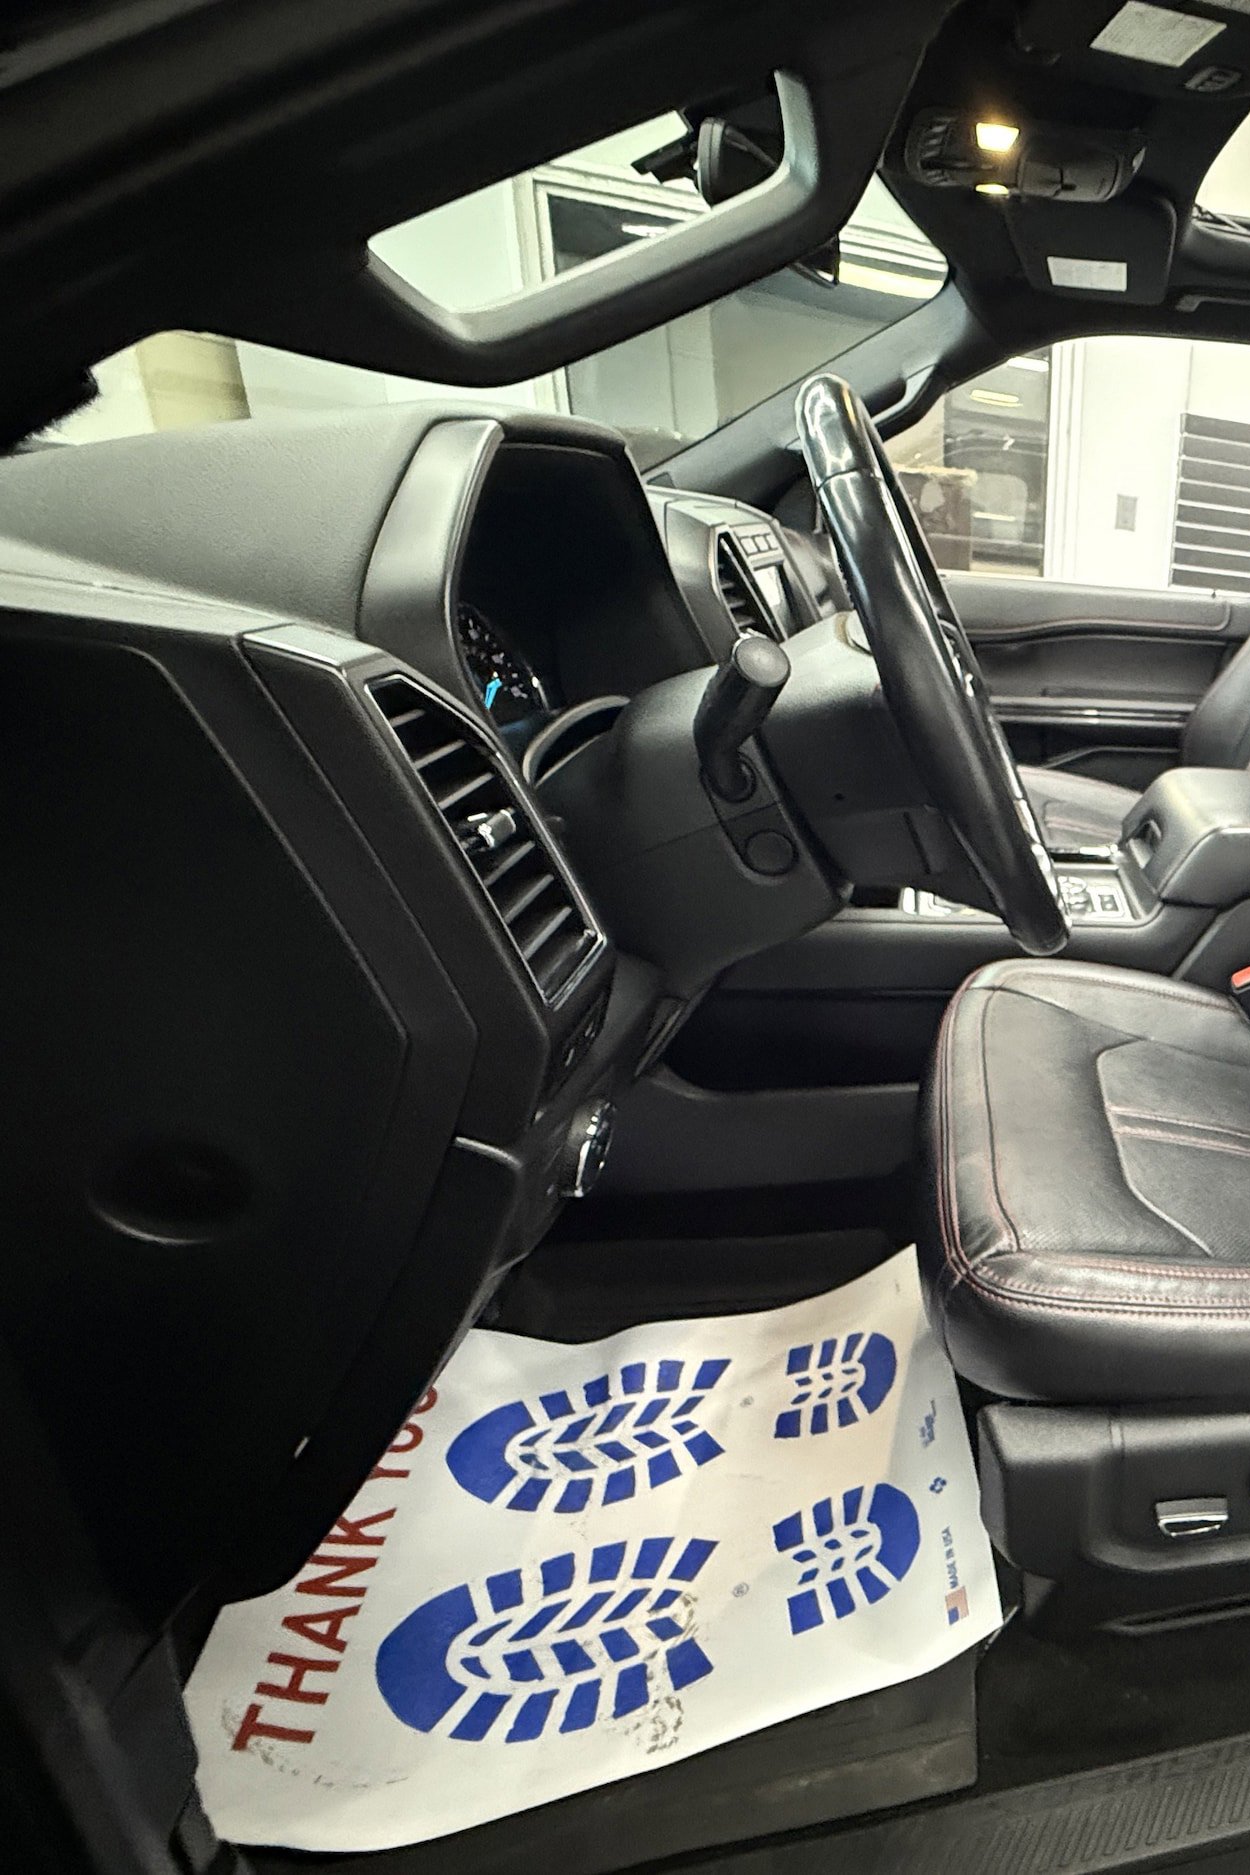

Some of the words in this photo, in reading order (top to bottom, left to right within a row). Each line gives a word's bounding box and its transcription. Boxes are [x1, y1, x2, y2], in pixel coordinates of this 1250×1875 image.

[941, 1526, 953, 1547] USA
[945, 1548, 955, 1560] IN
[946, 1561, 959, 1589] MADE
[231, 1506, 398, 1752] THANK
